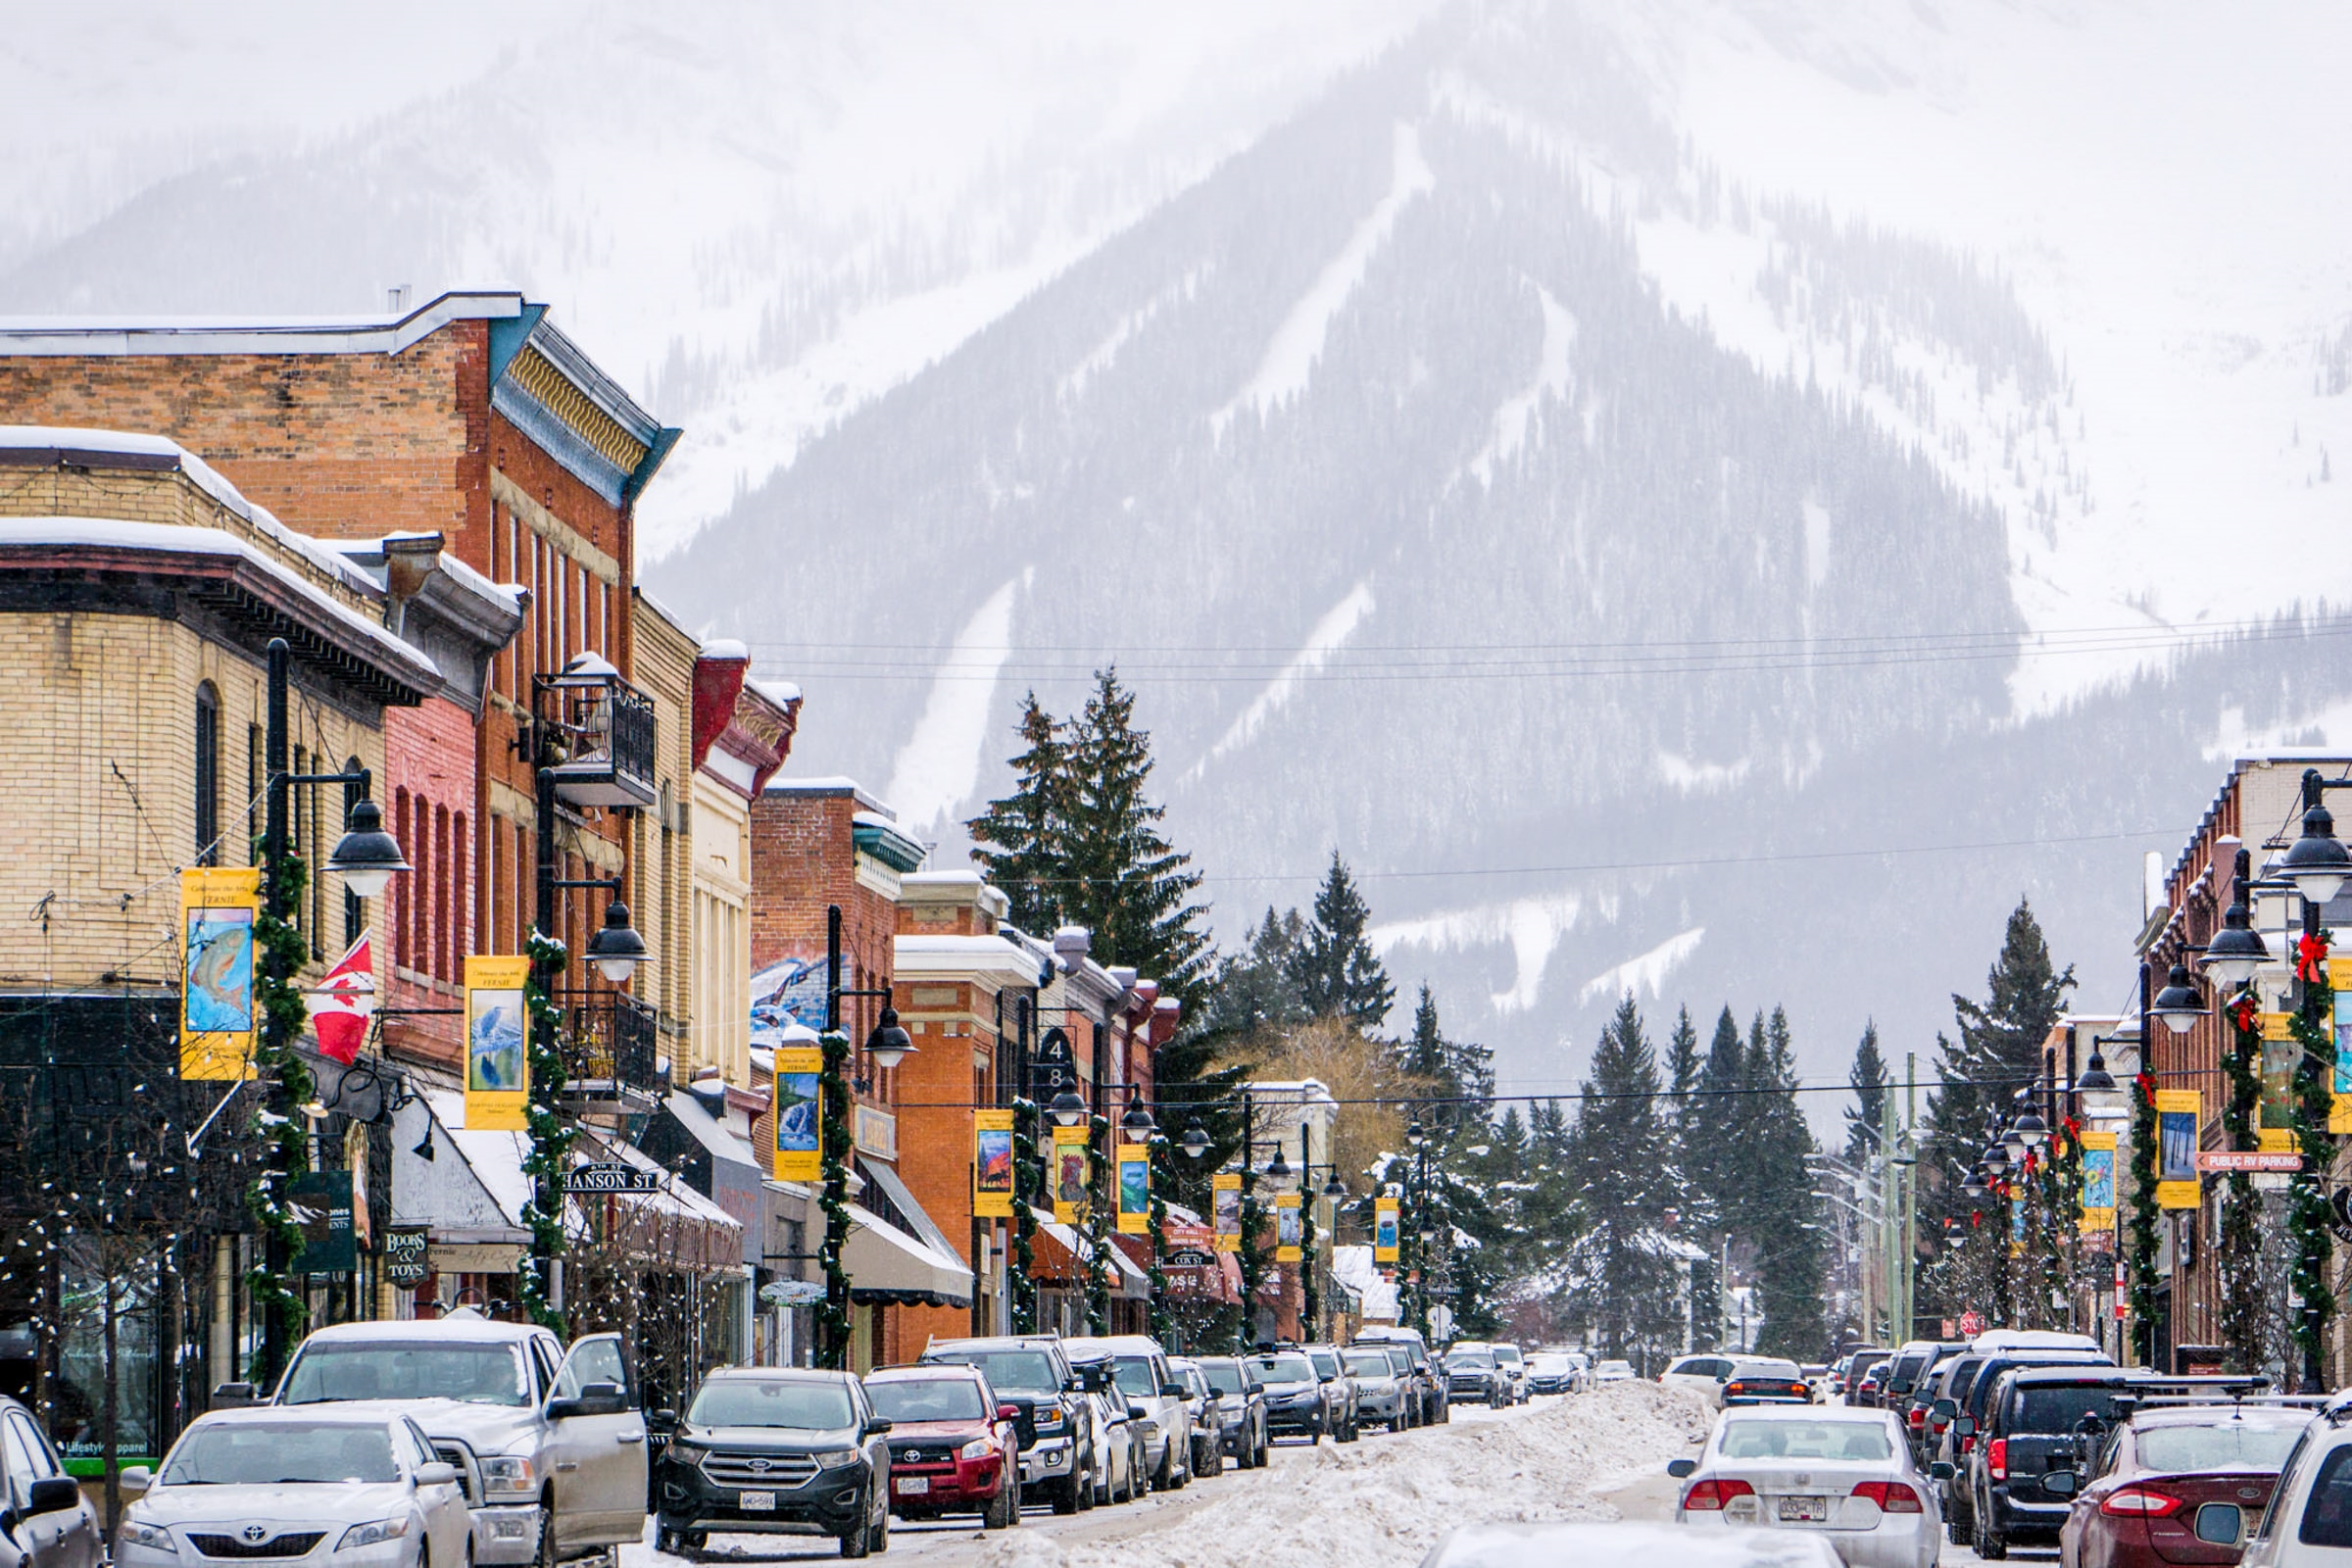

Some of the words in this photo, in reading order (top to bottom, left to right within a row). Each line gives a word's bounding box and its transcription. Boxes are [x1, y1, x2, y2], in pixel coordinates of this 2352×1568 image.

[2209, 1155, 2242, 1167] PUBLIC
[2243, 1155, 2258, 1167] RV
[2258, 1155, 2298, 1167] PARKING
[563, 1174, 627, 1189] HANSON
[634, 1174, 652, 1189] ST
[385, 1233, 425, 1252] BOOKS
[396, 1247, 416, 1262] &
[429, 1246, 457, 1255] Fernie
[1193, 1256, 1203, 1265] ST
[388, 1264, 423, 1277] TOYS
[111, 1442, 148, 1454] pparel
